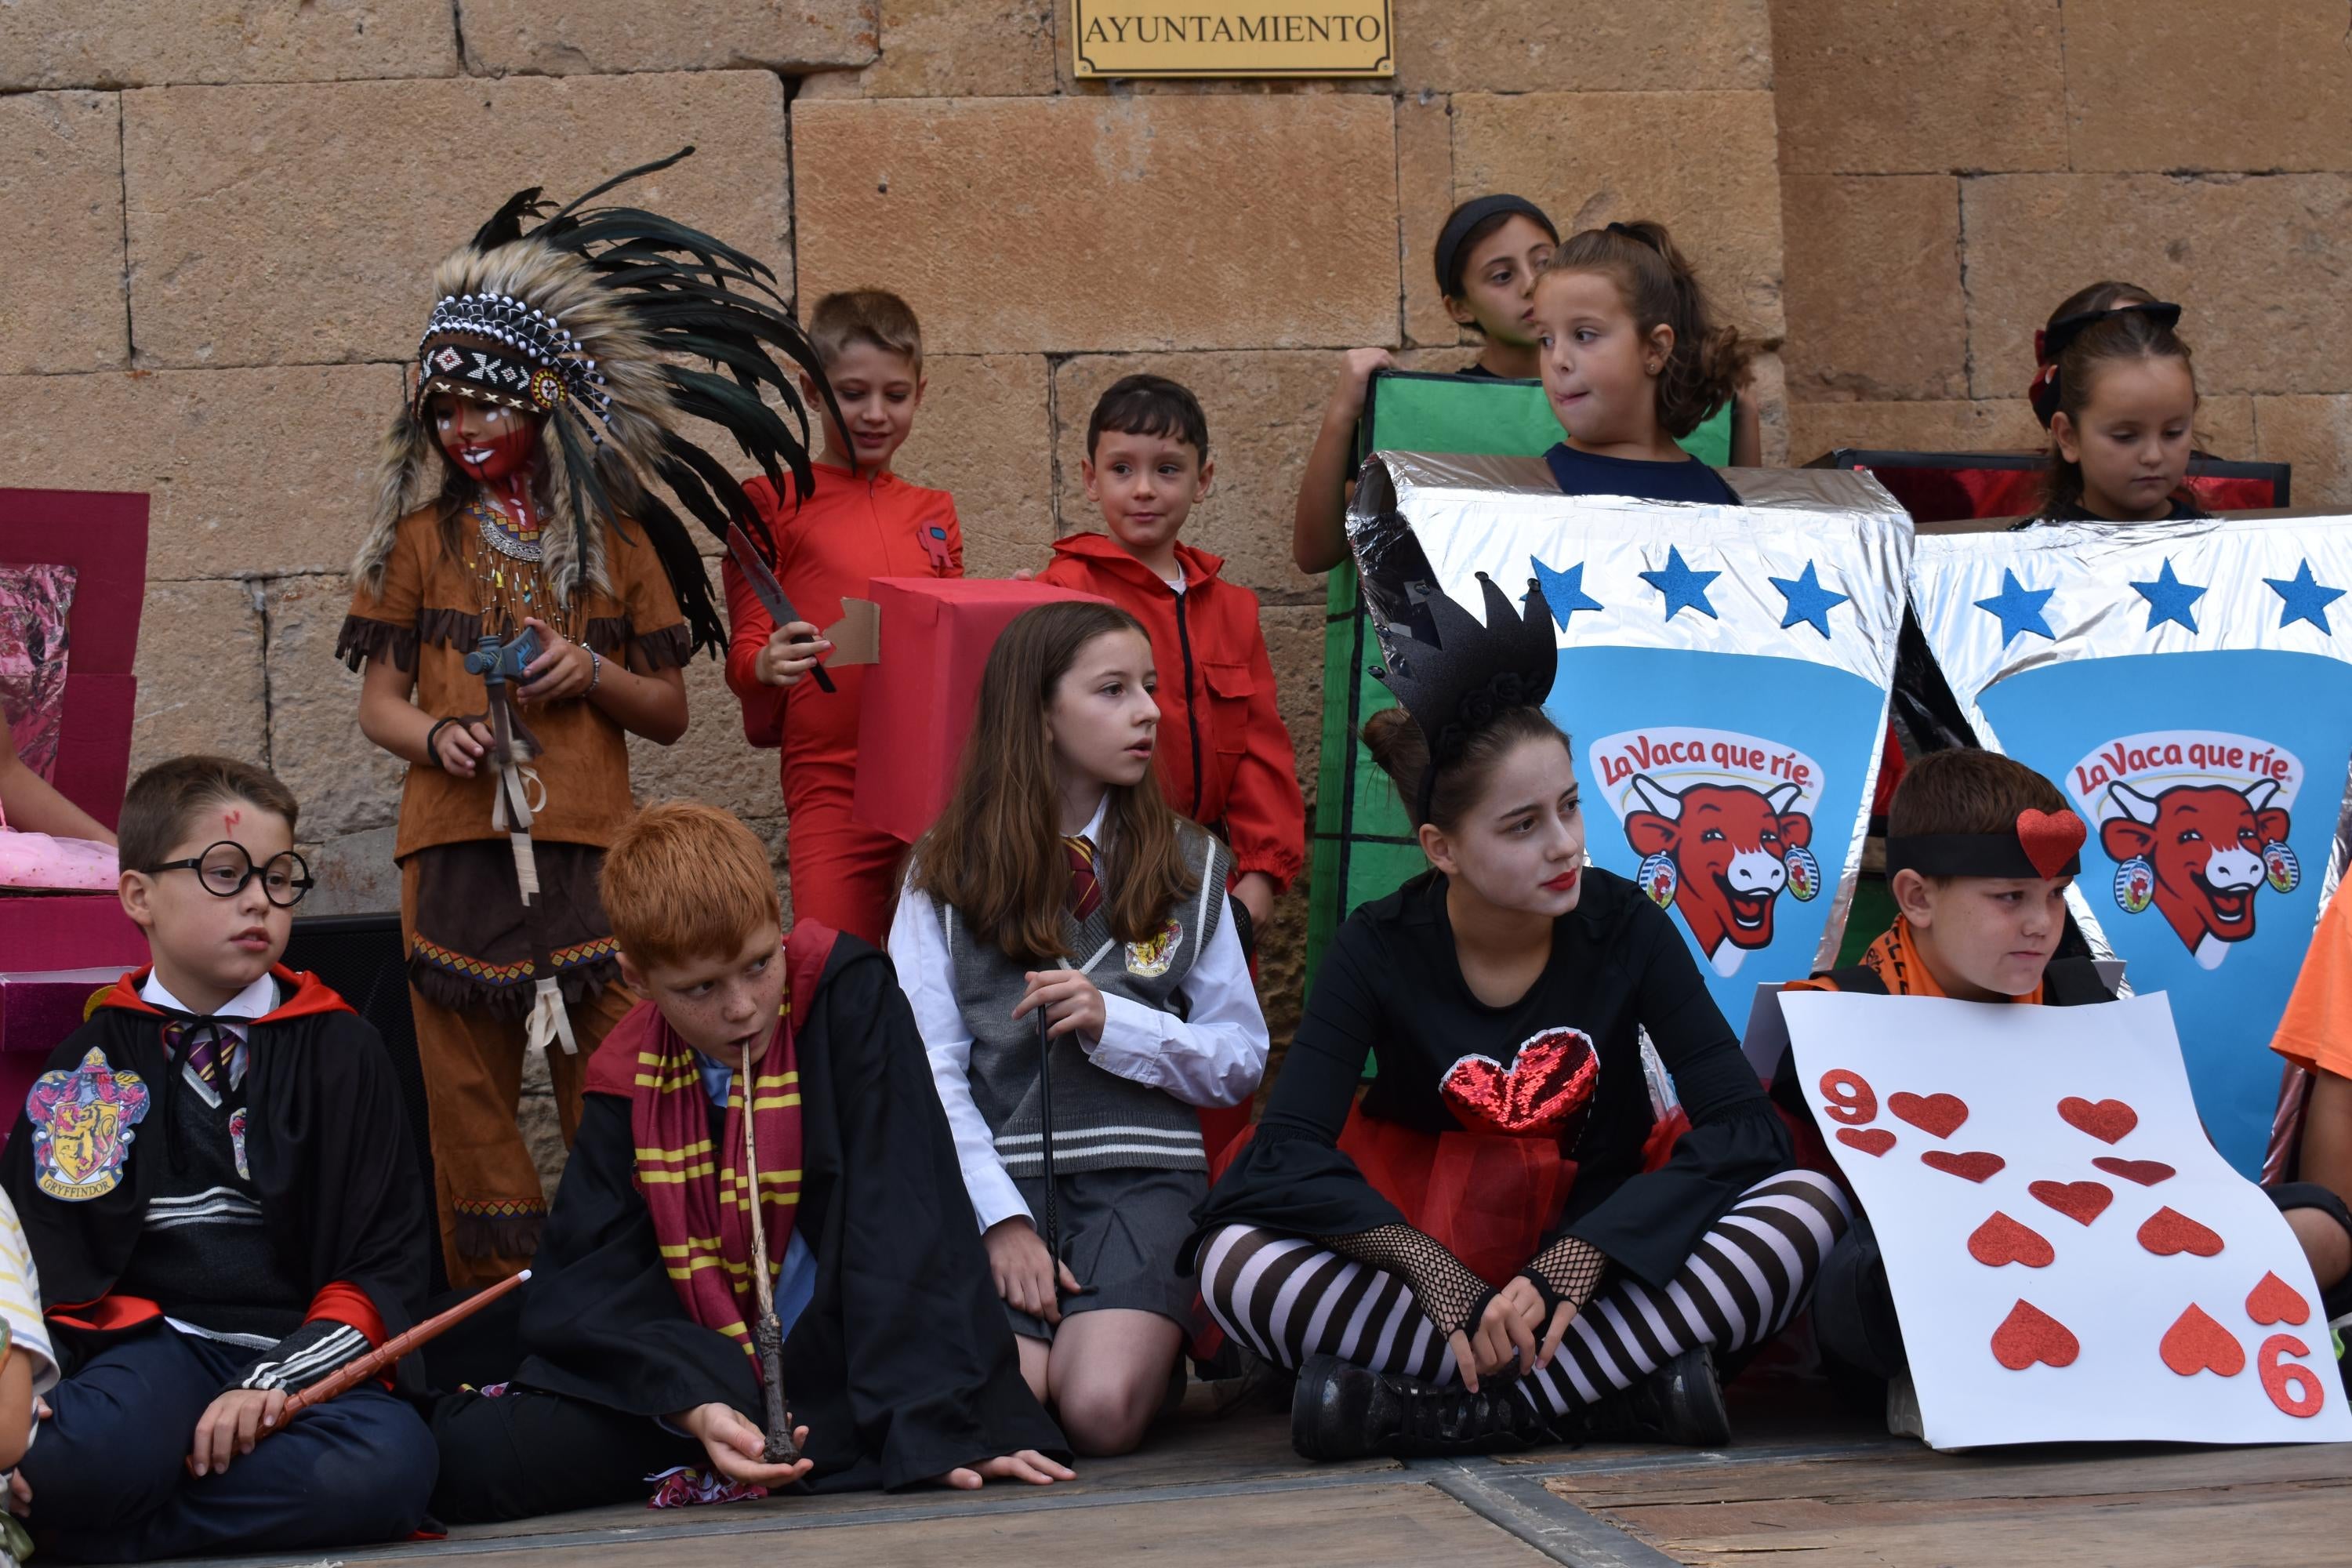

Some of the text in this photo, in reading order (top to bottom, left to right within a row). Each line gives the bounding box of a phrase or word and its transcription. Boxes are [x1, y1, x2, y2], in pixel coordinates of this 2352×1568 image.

[1085, 16, 1381, 42] AYUNTAMIENTO
[1599, 735, 1809, 787] La Vaca que ríe
[2075, 742, 2288, 796] La Vaca que ríe
[1820, 1069, 1878, 1125] 9
[44, 1178, 111, 1197] GRYFFINDOR
